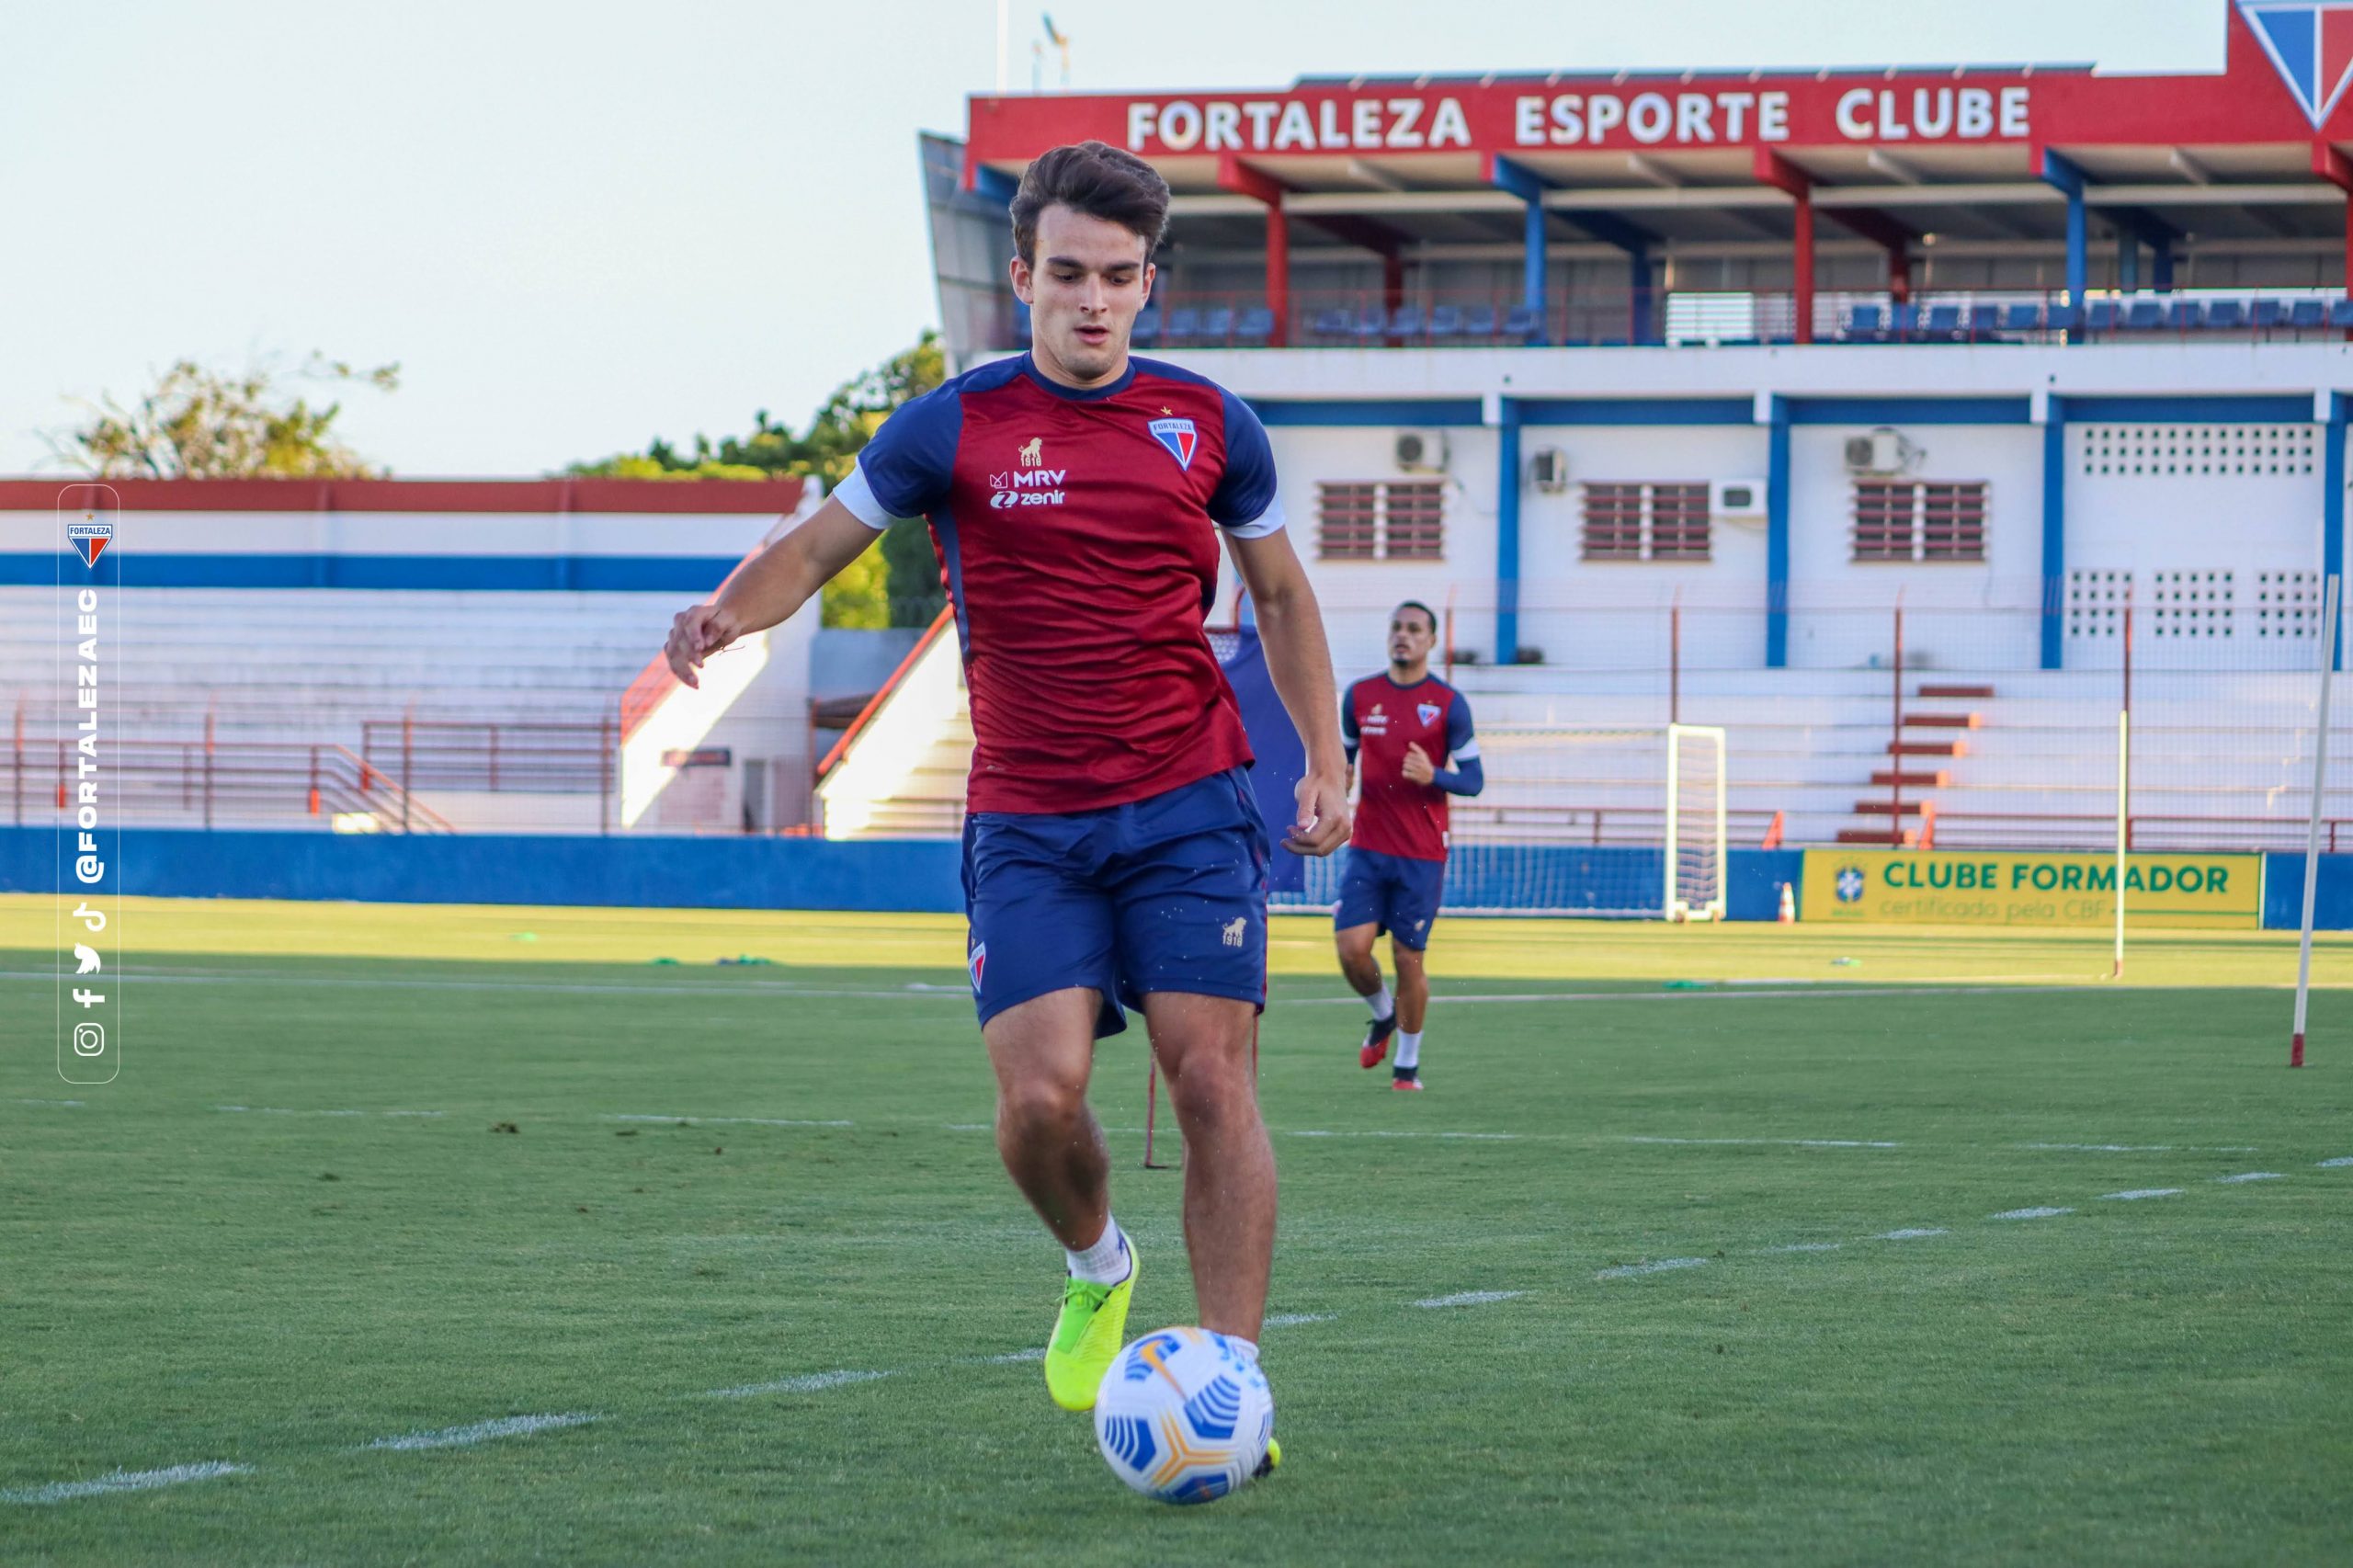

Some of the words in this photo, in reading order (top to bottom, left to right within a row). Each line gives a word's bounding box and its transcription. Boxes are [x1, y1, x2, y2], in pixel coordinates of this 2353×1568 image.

[1126, 97, 1472, 151] FORTALEZA
[1515, 91, 1790, 144] ESPORTE
[1836, 87, 2029, 140] CLUBE
[1020, 456, 1042, 467] 1918
[1013, 469, 1066, 488] MRV
[1020, 489, 1065, 506] zenir
[1882, 861, 1998, 889] CLUBE
[2011, 863, 2229, 894] FORMADOR
[1880, 898, 1999, 918] certificado
[2006, 899, 2056, 925] pela
[2063, 899, 2108, 920] CBF
[1222, 934, 1243, 948] 1918
